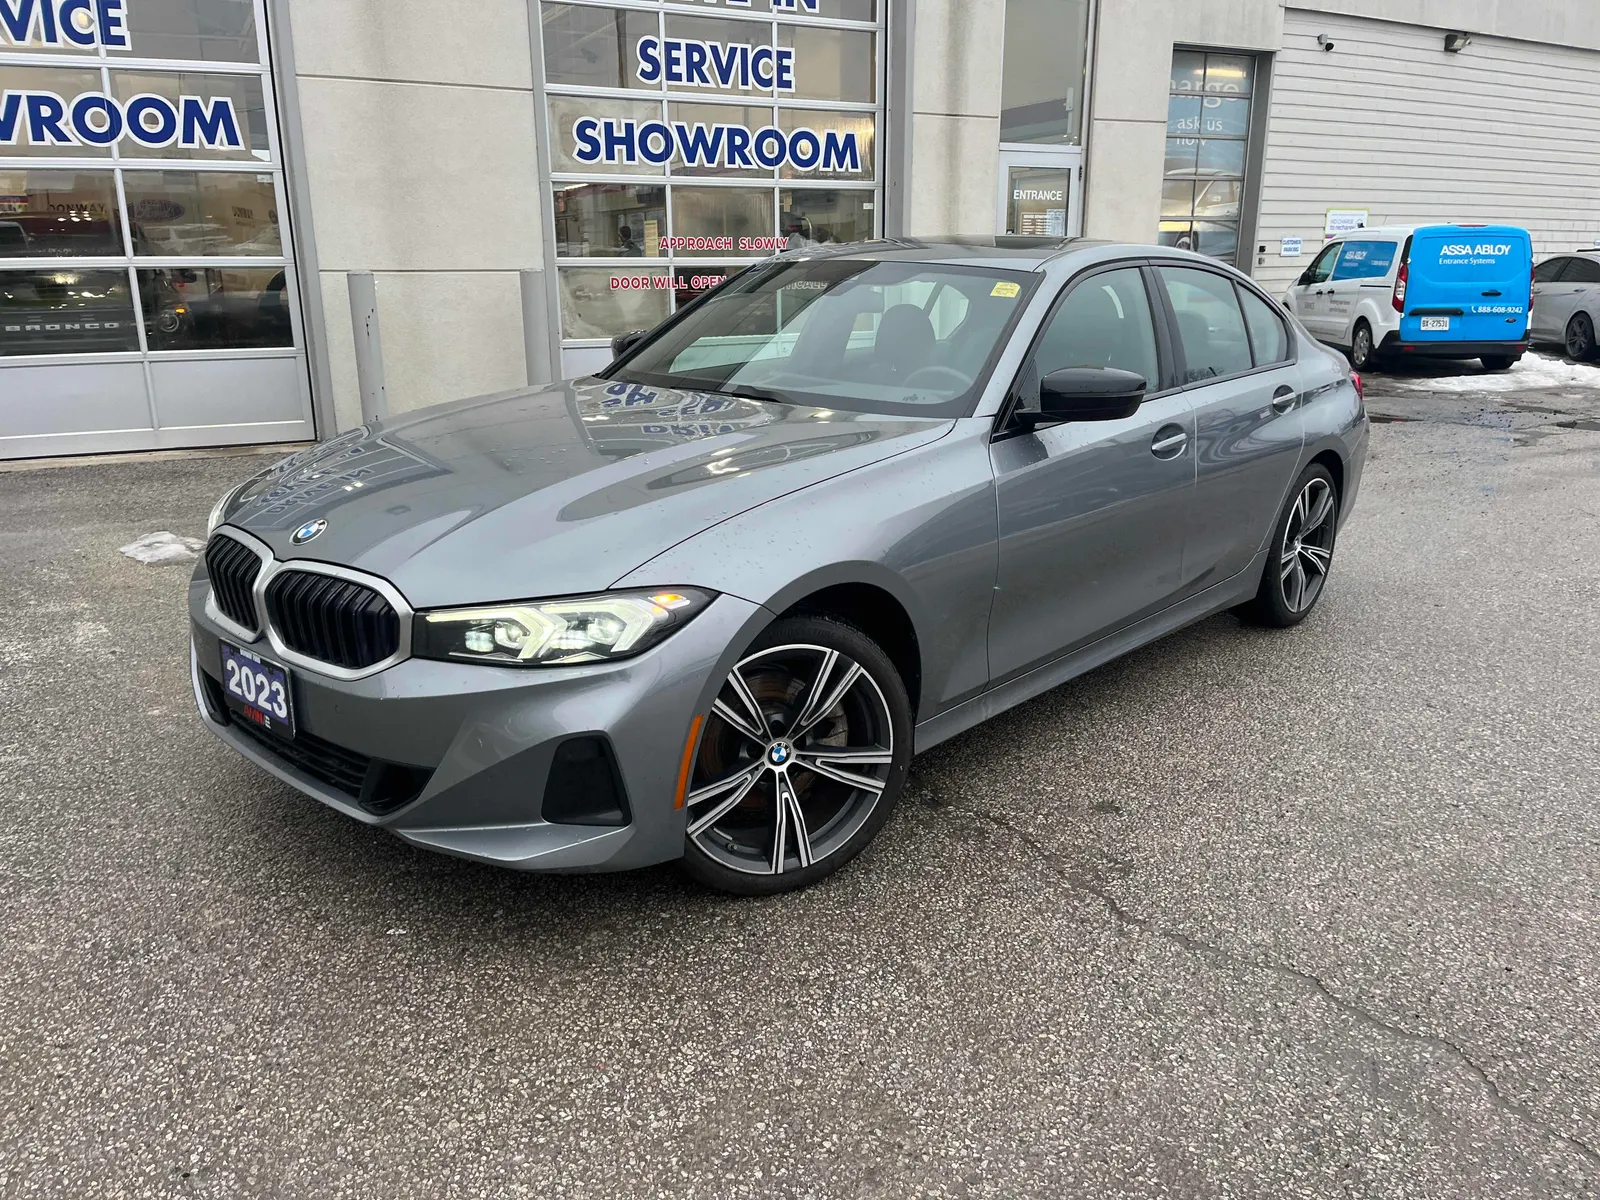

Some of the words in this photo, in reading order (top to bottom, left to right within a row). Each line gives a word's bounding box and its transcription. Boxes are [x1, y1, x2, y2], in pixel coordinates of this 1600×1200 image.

[636, 35, 796, 92] SERVICE
[0, 89, 245, 150] ROOM
[1177, 115, 1200, 130] ask
[1206, 120, 1223, 131] us
[572, 116, 862, 173] SHOWROOM
[1013, 189, 1063, 201] ENTRANCE
[659, 236, 732, 250] APPROACH
[738, 236, 789, 250] SLOWLY
[1440, 244, 1472, 256] ASSA
[1473, 244, 1511, 256] ABLOY
[1469, 257, 1496, 266] Systems
[610, 276, 650, 290] DOOR
[653, 276, 687, 290] WILL
[1477, 305, 1523, 314] 888-608-9242
[5, 322, 119, 331] BRONCO
[226, 658, 288, 719] 2023
